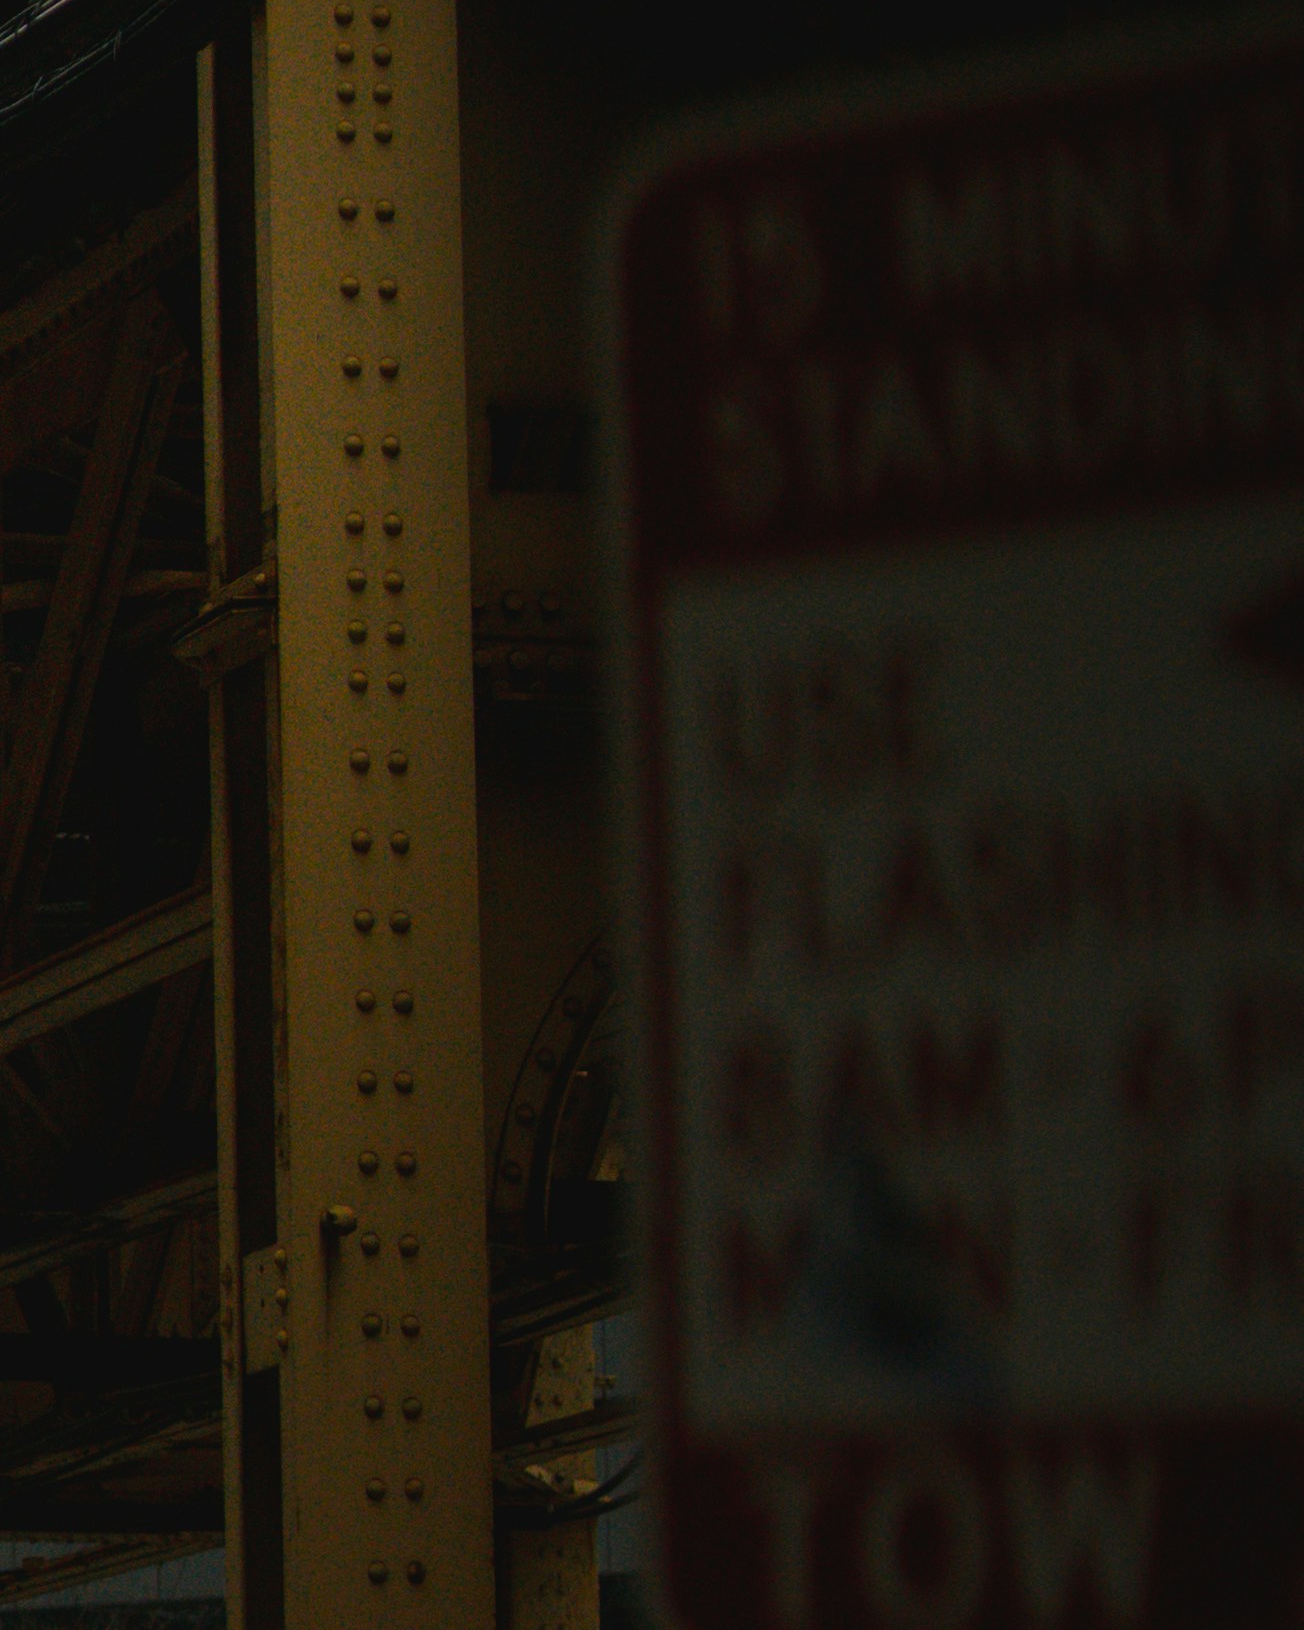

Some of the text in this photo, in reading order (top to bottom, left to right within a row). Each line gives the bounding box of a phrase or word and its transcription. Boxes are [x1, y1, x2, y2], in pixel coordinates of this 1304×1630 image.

[699, 178, 824, 342] 15
[712, 624, 948, 800] USE
[720, 1192, 1013, 1343] MN
